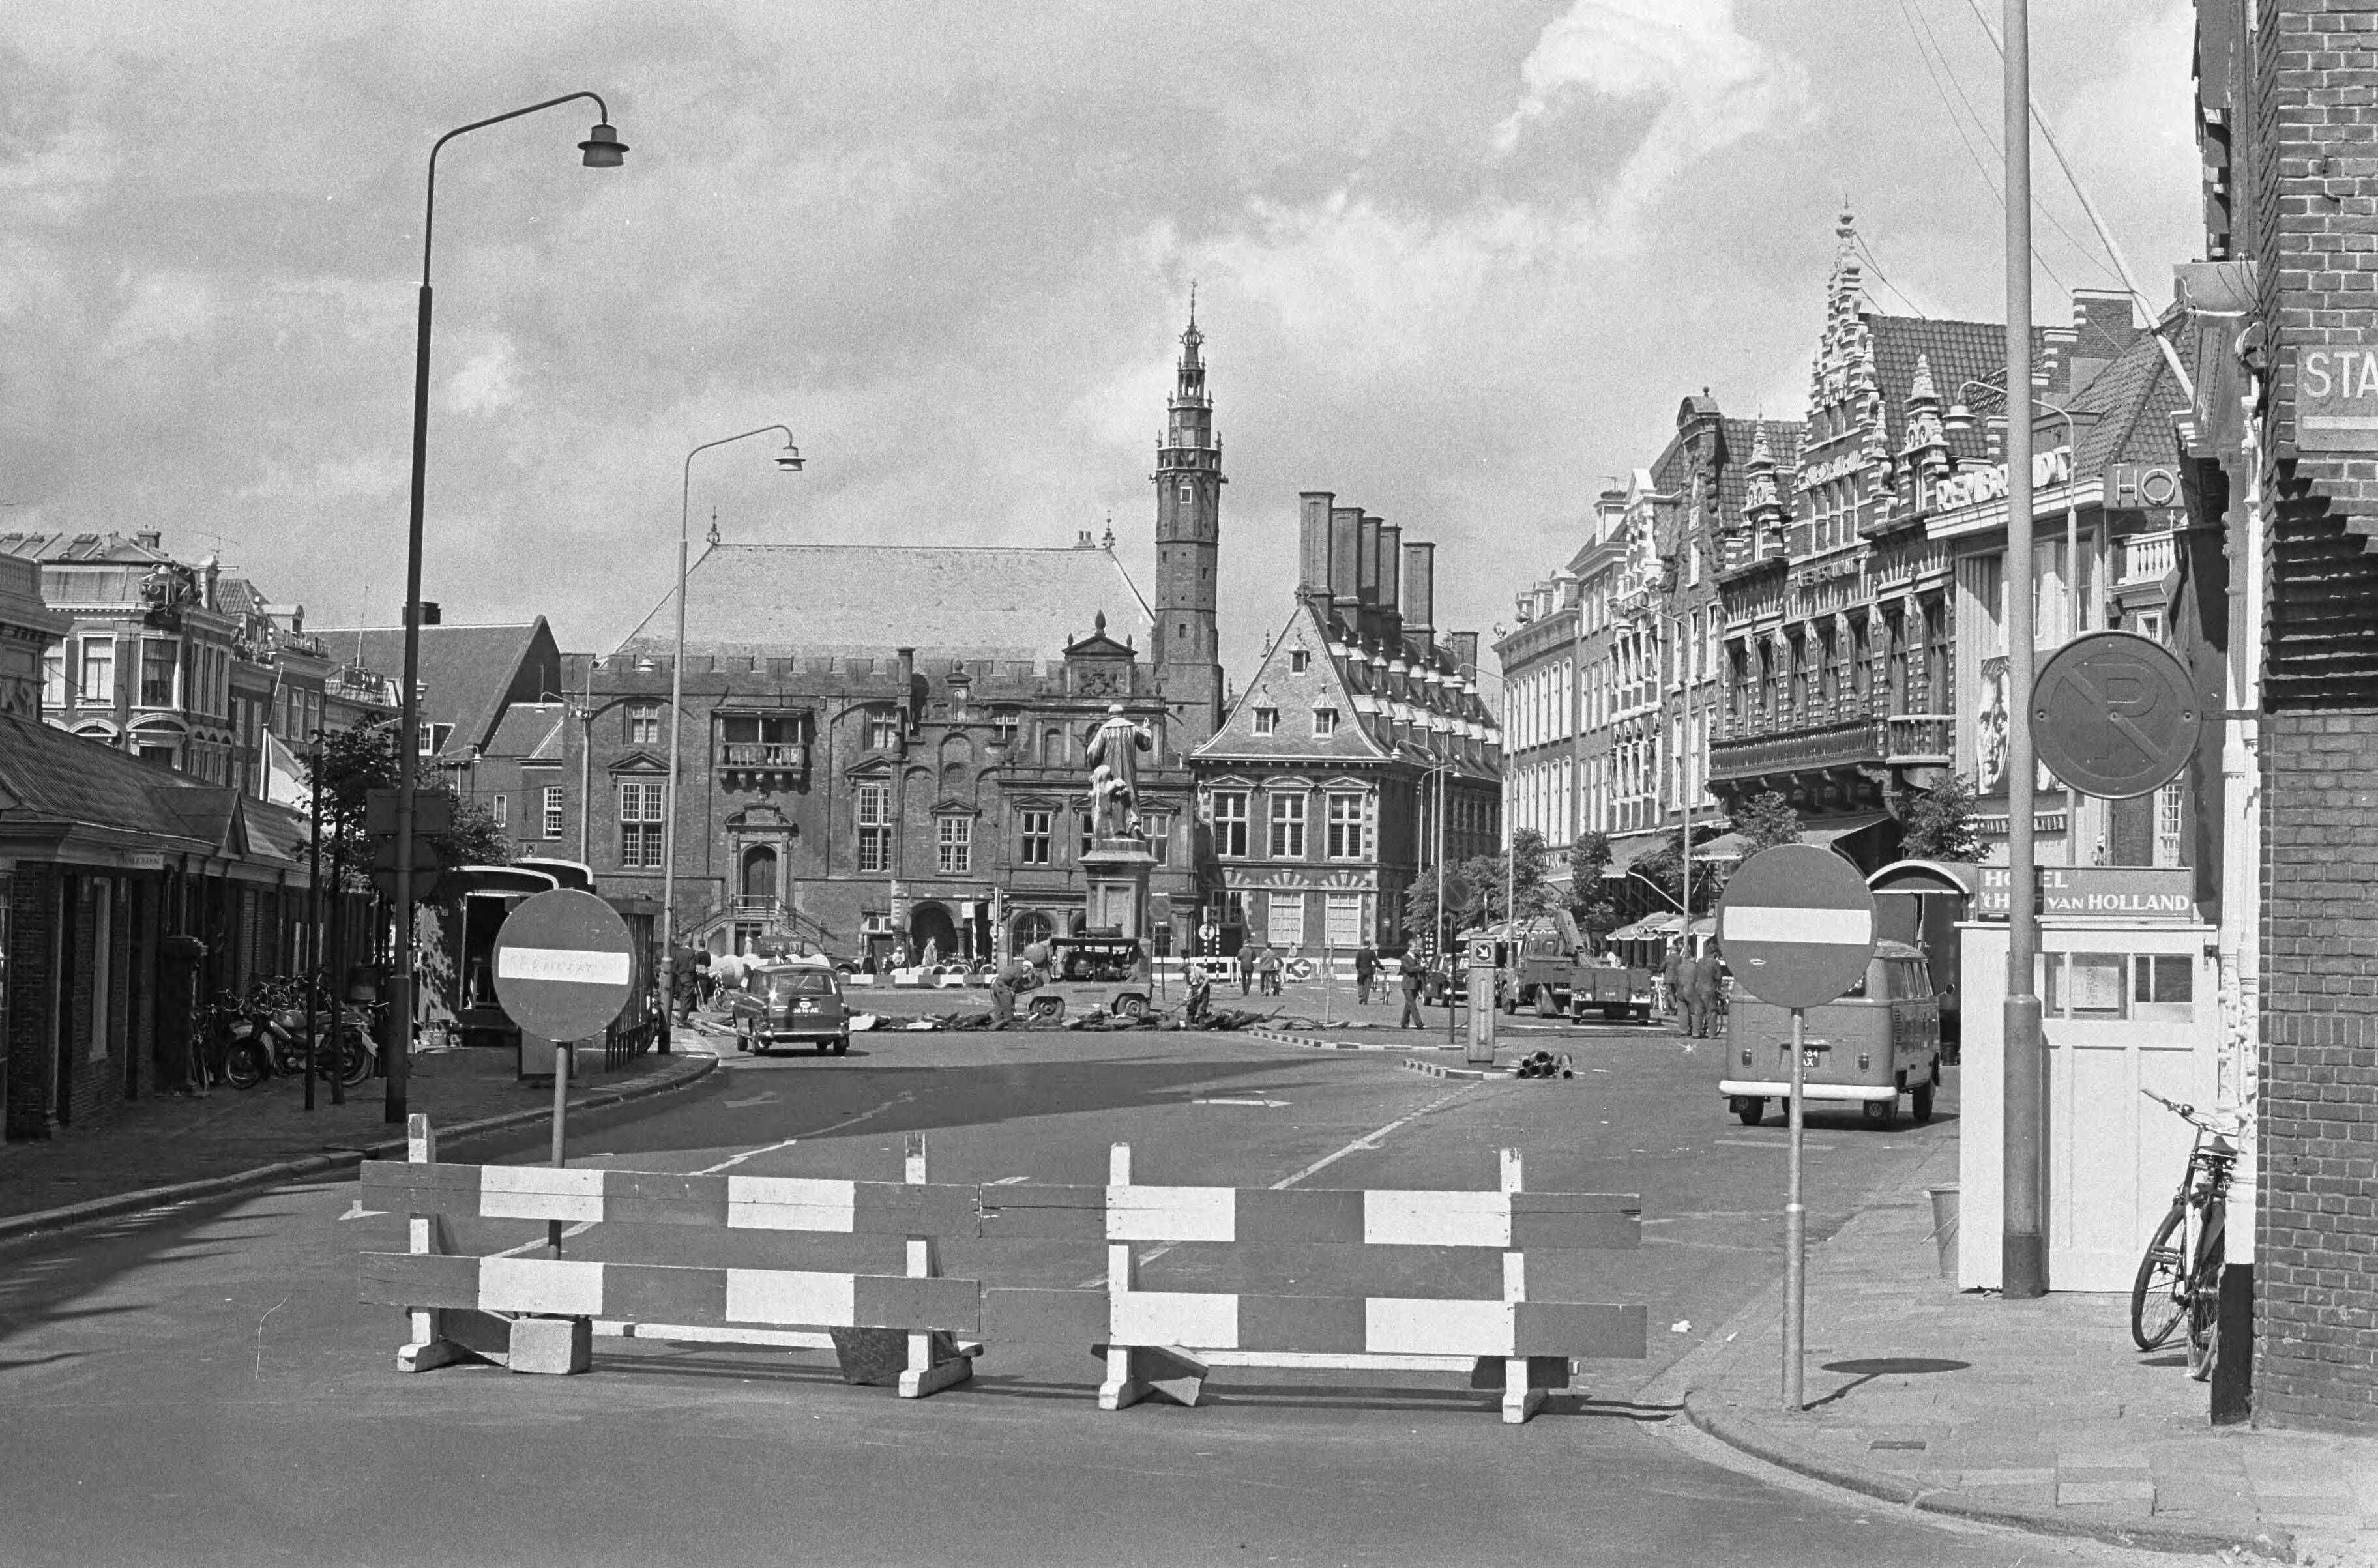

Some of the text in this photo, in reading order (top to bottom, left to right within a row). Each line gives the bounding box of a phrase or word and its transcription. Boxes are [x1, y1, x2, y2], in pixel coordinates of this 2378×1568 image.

[1984, 871, 2068, 888] HEL
[2048, 897, 2085, 909] VAN
[2087, 894, 2190, 911] HOLLAND
